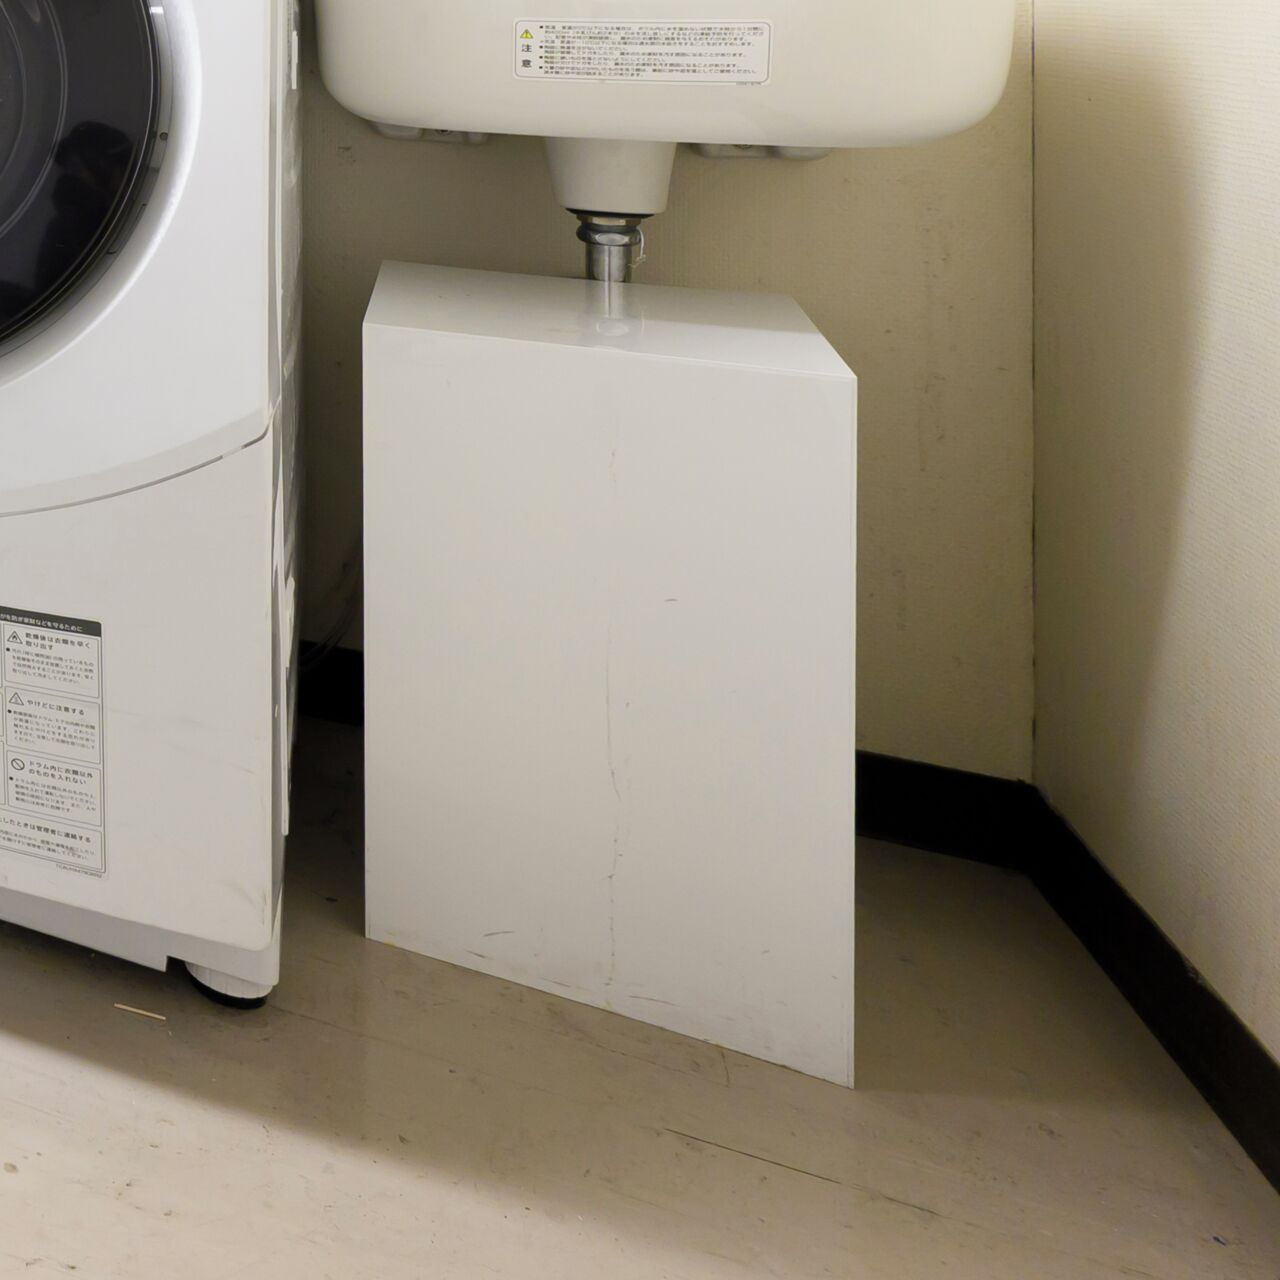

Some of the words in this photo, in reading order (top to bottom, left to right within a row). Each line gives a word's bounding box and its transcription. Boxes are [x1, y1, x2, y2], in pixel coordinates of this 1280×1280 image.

[521, 44, 532, 68] 注意
[25, 632, 91, 649] 乾燥後は衣類を早く
[25, 640, 54, 651] 取り出す
[26, 698, 85, 716] やけどに注意する
[28, 768, 87, 785] のものを入れない
[29, 760, 94, 779] ドラム内に衣類以外
